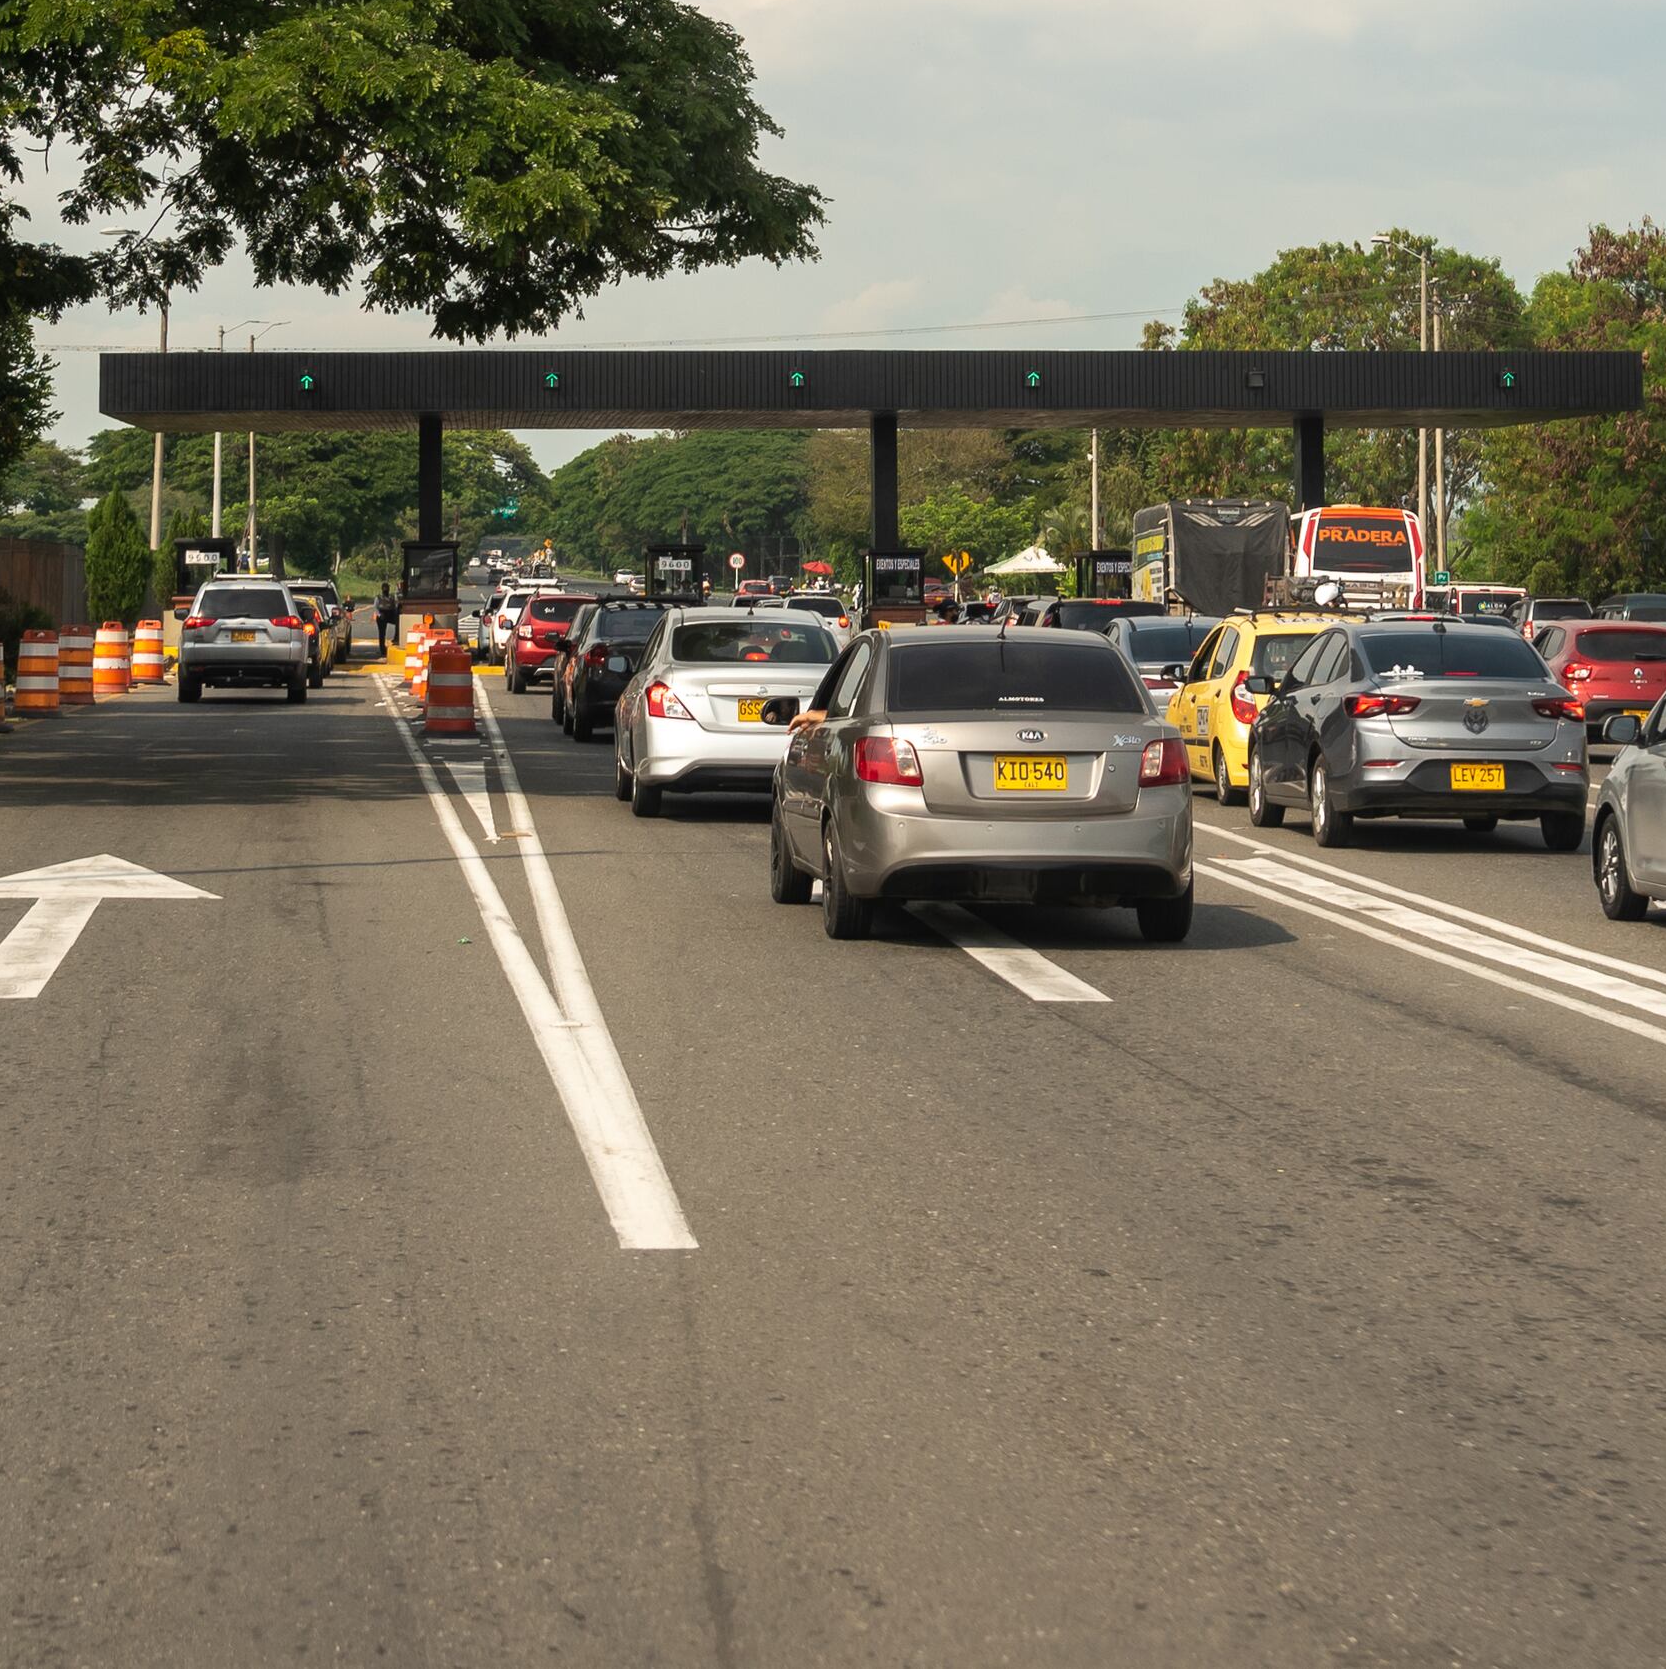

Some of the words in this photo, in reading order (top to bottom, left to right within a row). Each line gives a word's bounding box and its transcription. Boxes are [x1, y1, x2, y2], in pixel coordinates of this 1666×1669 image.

[1319, 529, 1407, 544] PRADERA
[660, 560, 690, 569] 9600
[739, 702, 761, 716] GSS
[1021, 730, 1042, 740] KIA
[997, 761, 1029, 781] KIO
[1033, 762, 1064, 781] 540
[1454, 768, 1476, 782] LEV
[1479, 769, 1502, 782] 257
